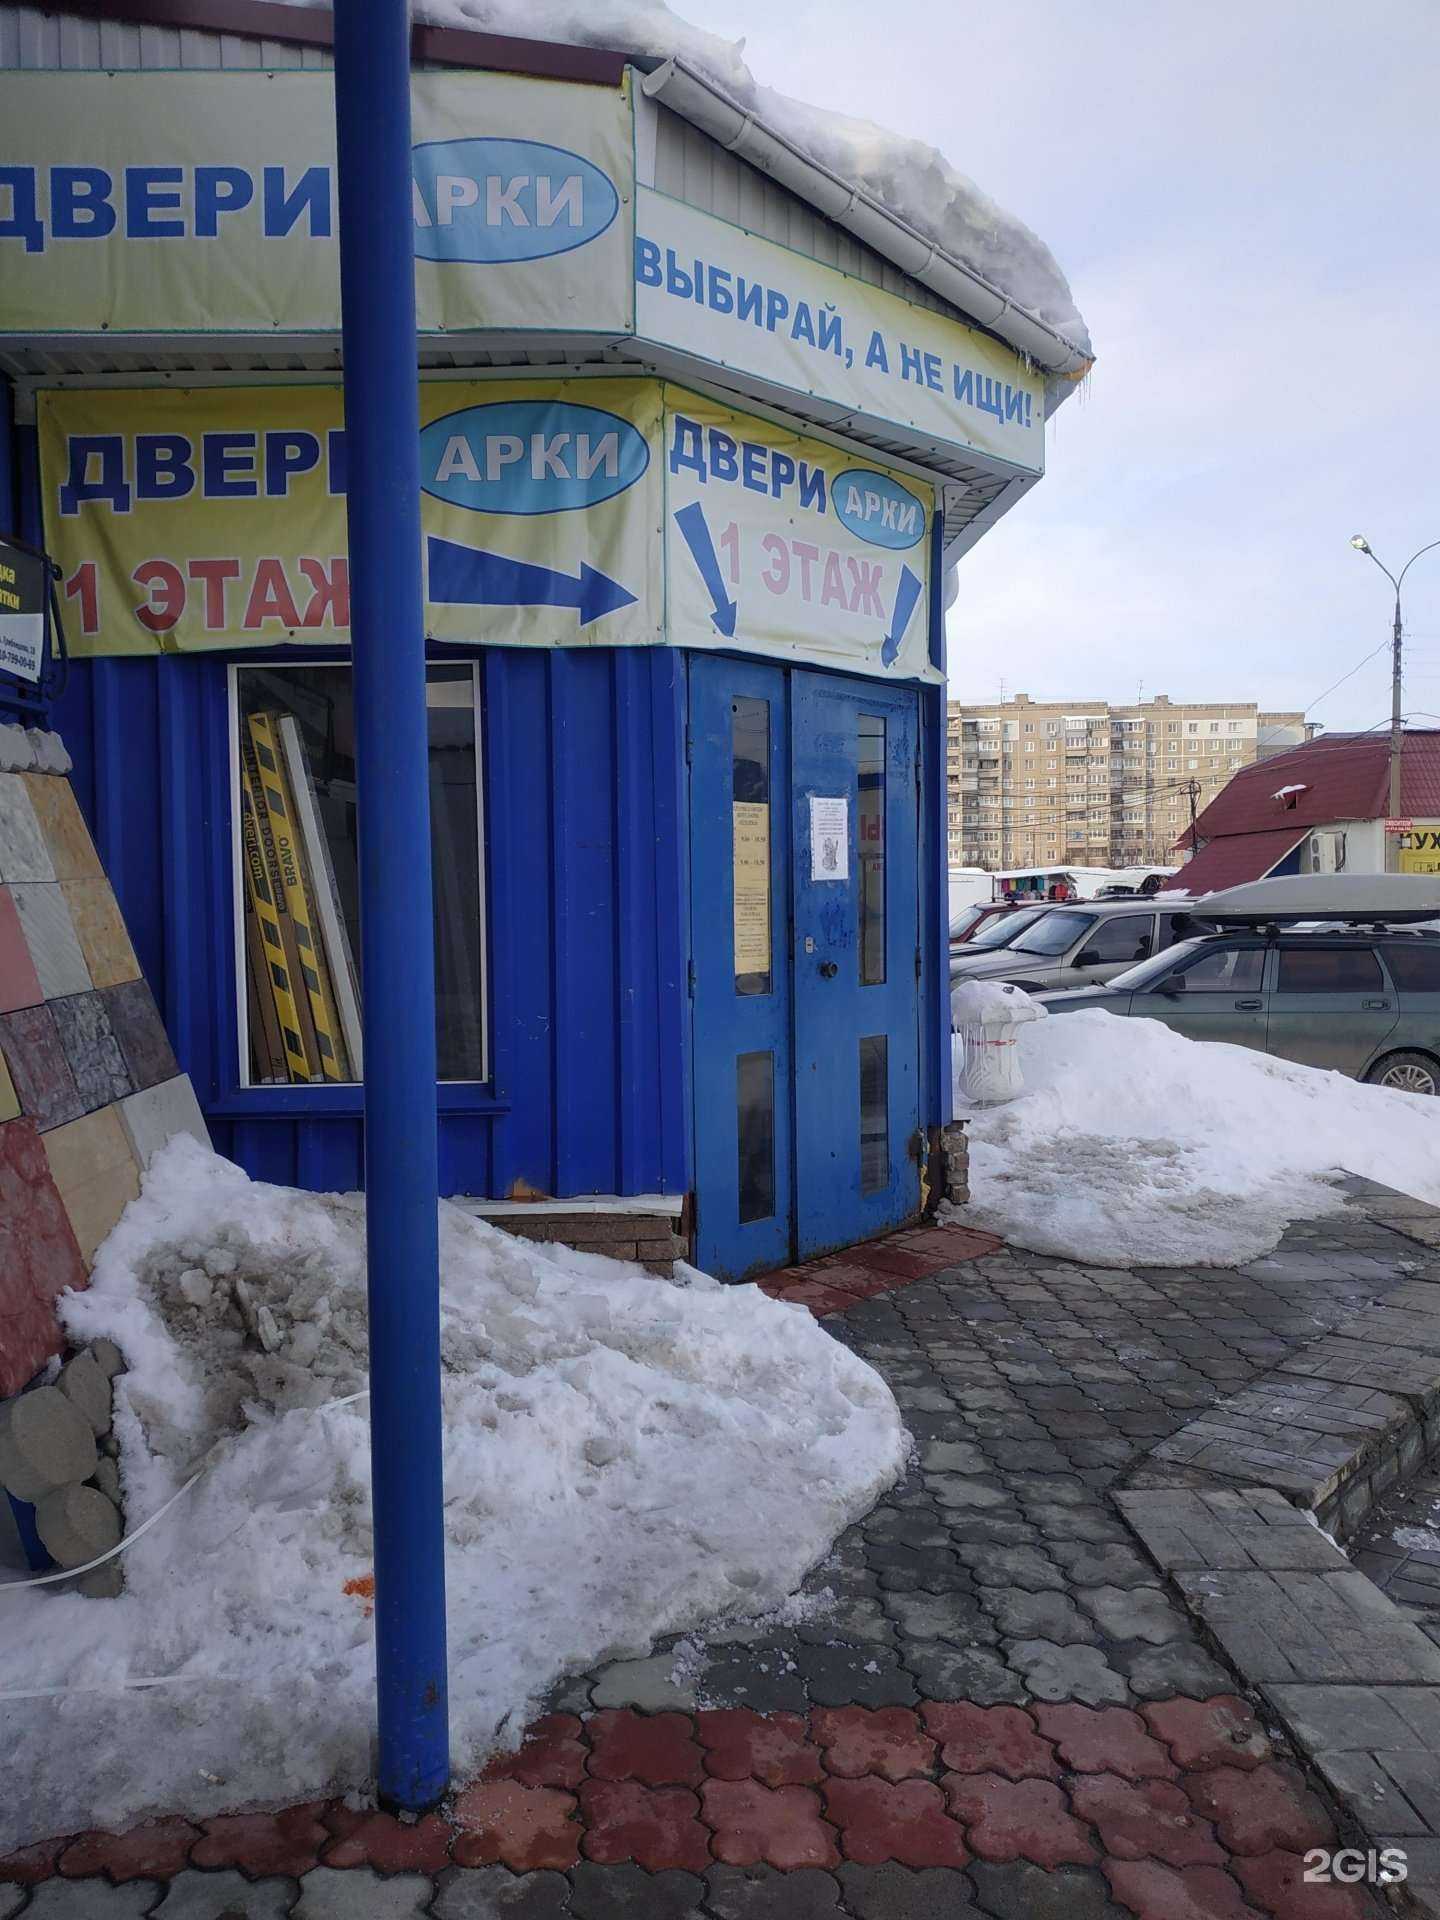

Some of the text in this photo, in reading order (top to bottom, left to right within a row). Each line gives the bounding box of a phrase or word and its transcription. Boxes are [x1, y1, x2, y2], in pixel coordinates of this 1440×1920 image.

[0, 166, 332, 253] ДВЕРИ
[635, 236, 1032, 428] ВЫБИРАЙ, А НЕ ИЩИ!
[60, 430, 619, 515] ДВЕР АРКИ
[669, 412, 917, 536] ДВЕРИ АРКИ
[65, 562, 98, 633] 1
[720, 521, 886, 620] 1 ЭТАЖ
[278, 836, 298, 888] BRAVO
